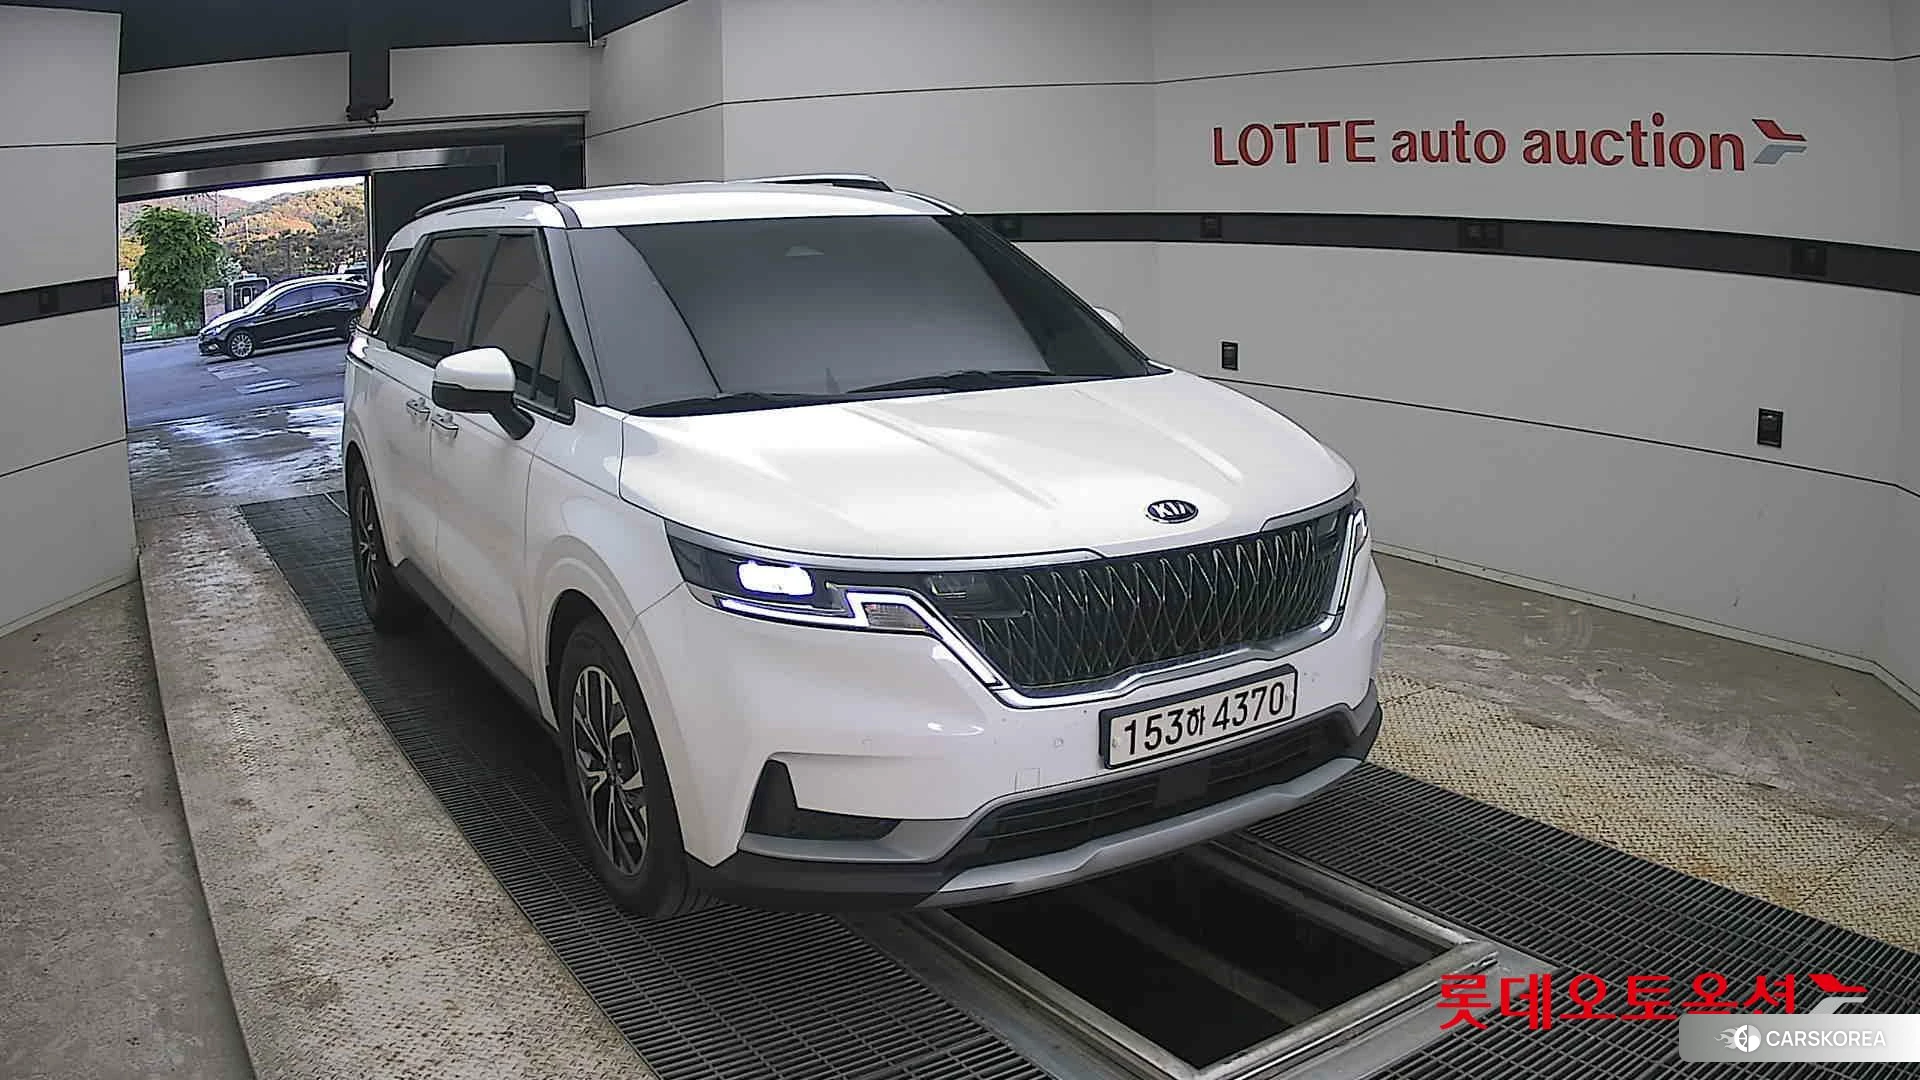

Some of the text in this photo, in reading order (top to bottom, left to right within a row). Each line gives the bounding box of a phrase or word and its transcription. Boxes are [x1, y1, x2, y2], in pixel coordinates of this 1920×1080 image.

[1212, 112, 1744, 171] LOTTE auto auction
[1153, 501, 1193, 519] KIA
[1124, 681, 1285, 755] 153하 4370
